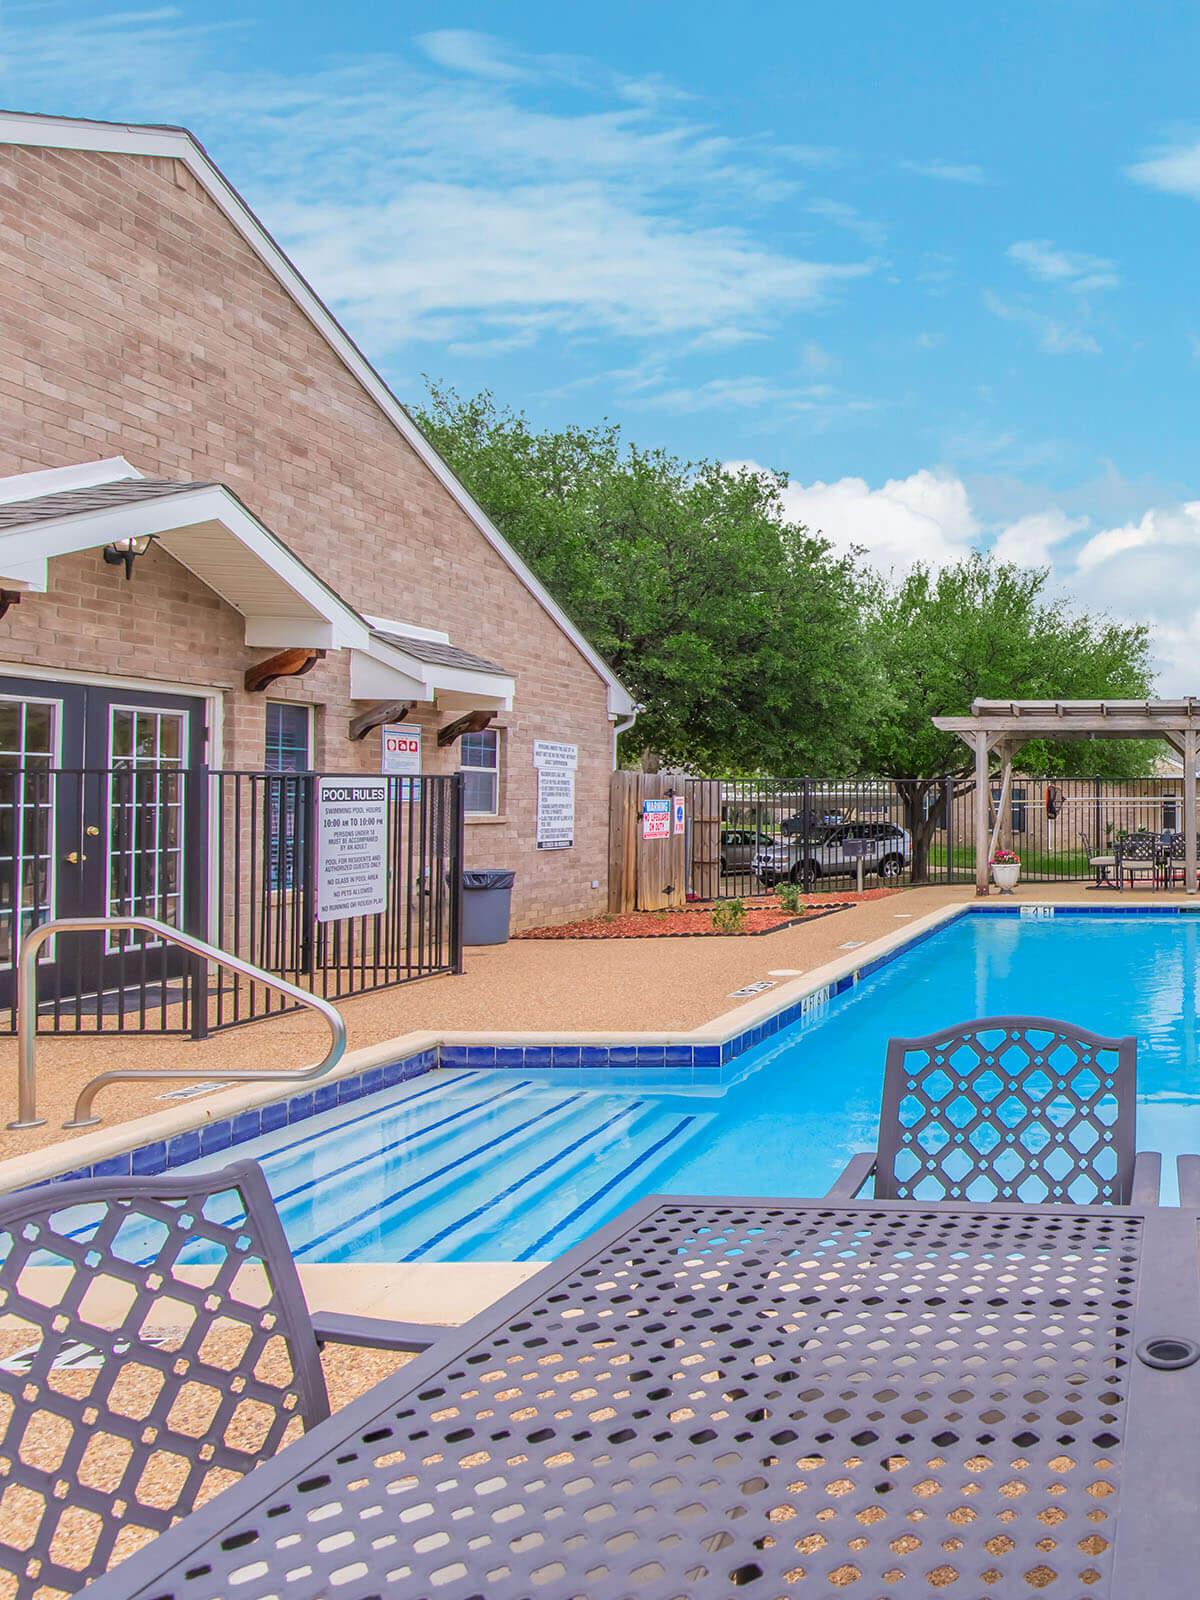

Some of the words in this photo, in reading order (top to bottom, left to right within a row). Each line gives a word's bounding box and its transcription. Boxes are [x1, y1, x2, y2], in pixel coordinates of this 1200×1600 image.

[323, 789, 351, 801] POOL
[353, 789, 384, 800] RULES
[325, 807, 351, 815] SWIMMING
[645, 813, 650, 821] NO
[324, 819, 341, 828] 10:00
[350, 818, 358, 826] TO
[360, 817, 375, 826] 10:00
[649, 822, 654, 831] ON
[655, 822, 664, 831] DUTY
[348, 855, 371, 863] RESIDENTS
[325, 864, 352, 872] AUTHORIZED
[353, 862, 369, 870] GUESTS
[352, 886, 373, 895] ALLOWED
[329, 902, 349, 911] RUNNING
